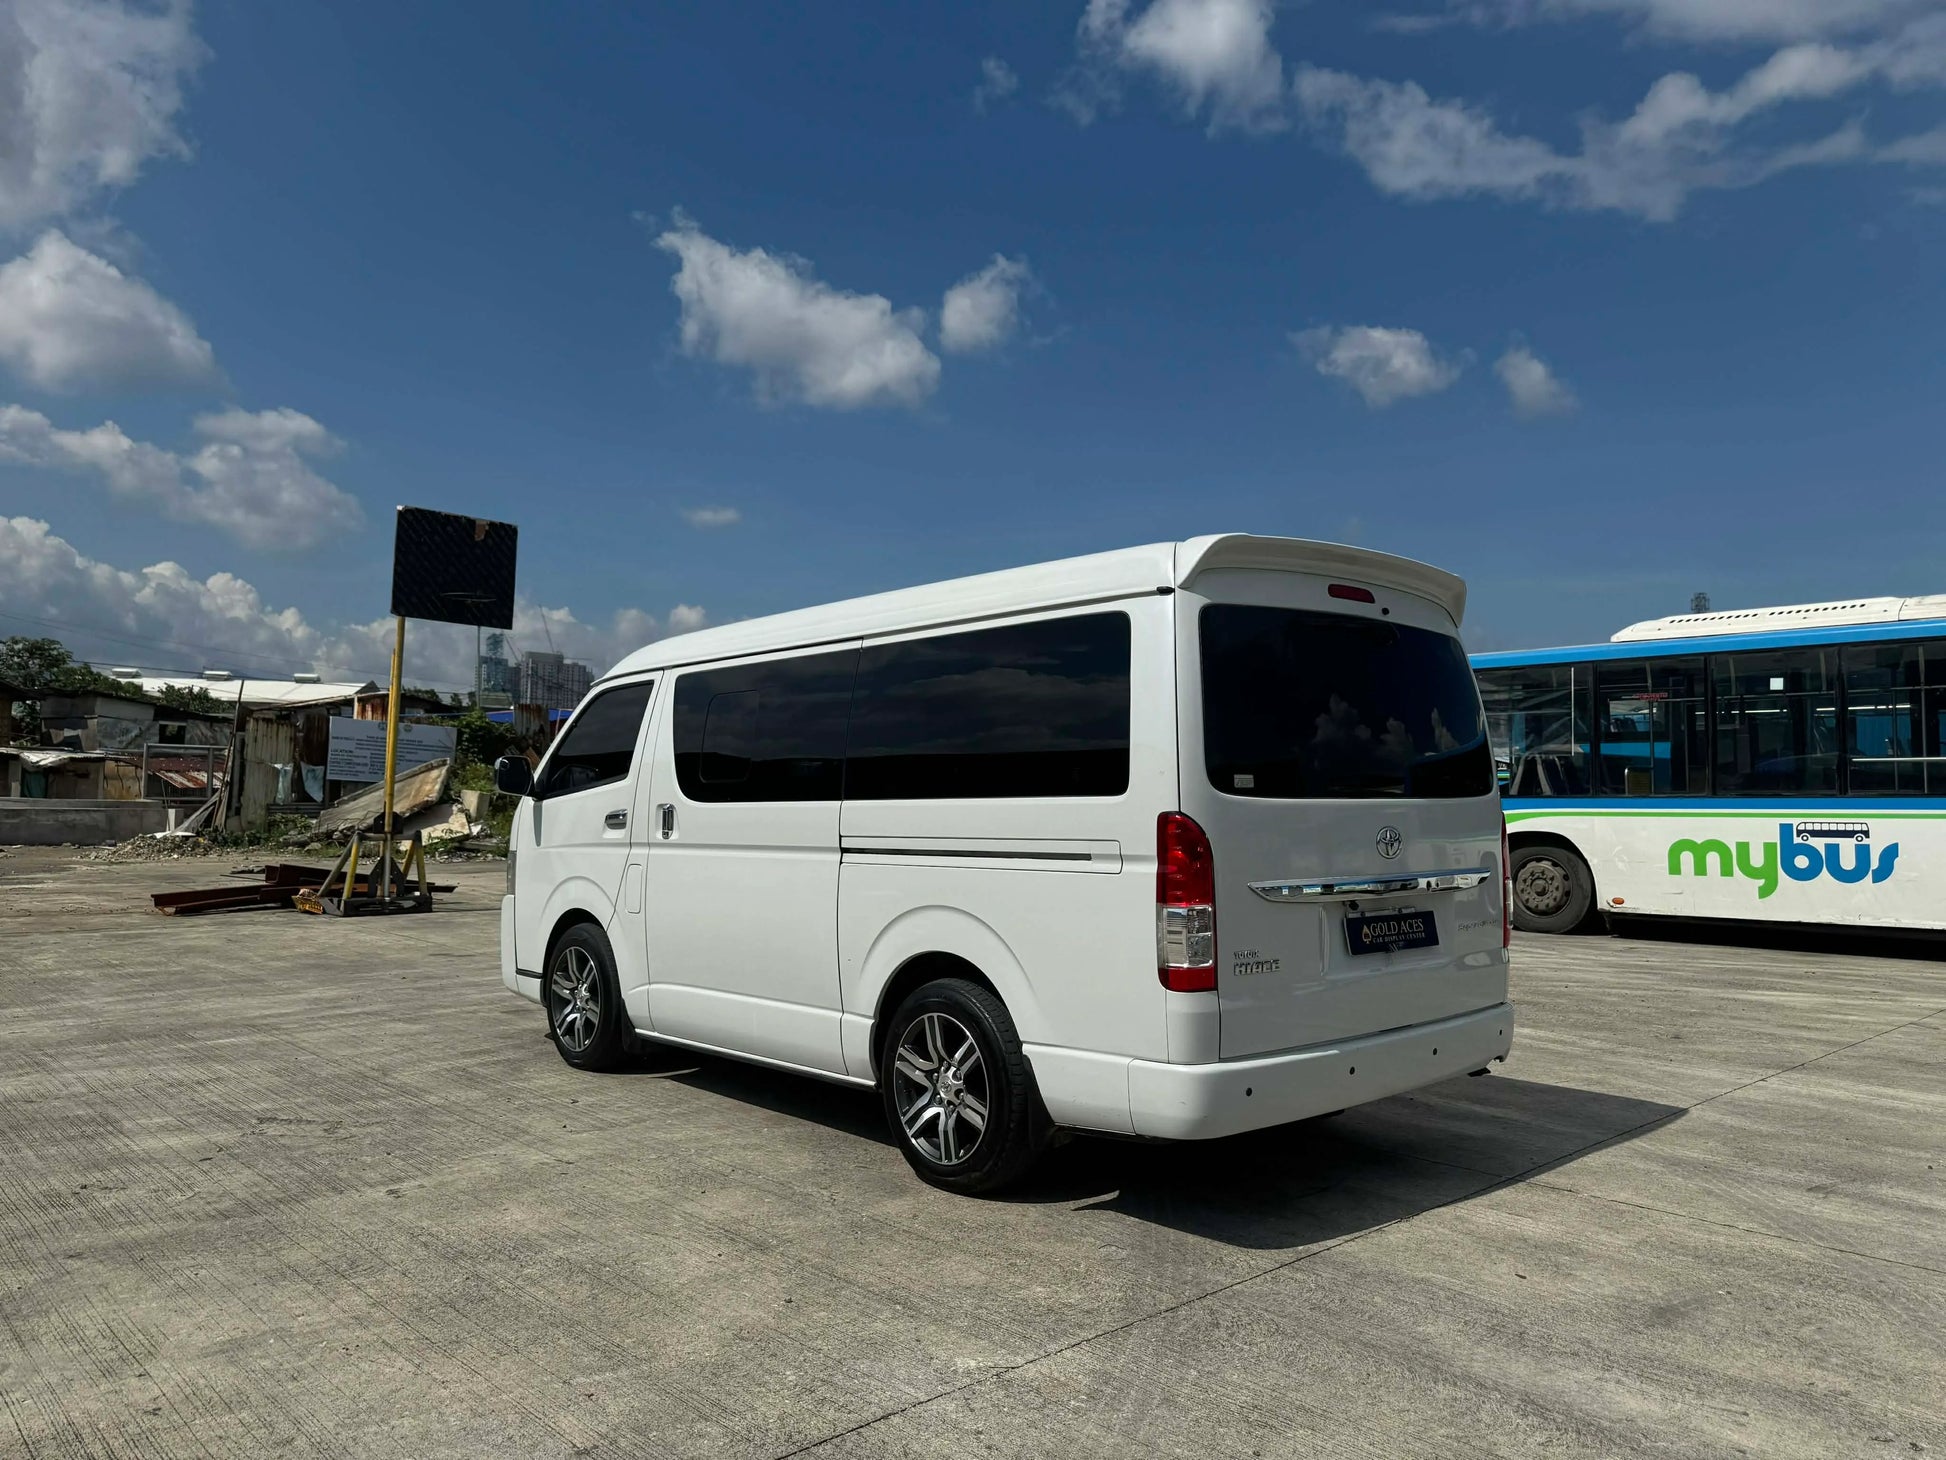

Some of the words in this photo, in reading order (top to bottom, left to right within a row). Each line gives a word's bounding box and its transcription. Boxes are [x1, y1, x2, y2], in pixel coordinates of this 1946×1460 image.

[1370, 921, 1398, 936] GOLD
[1400, 919, 1424, 934] ACES
[1384, 934, 1405, 943] DISPLAY
